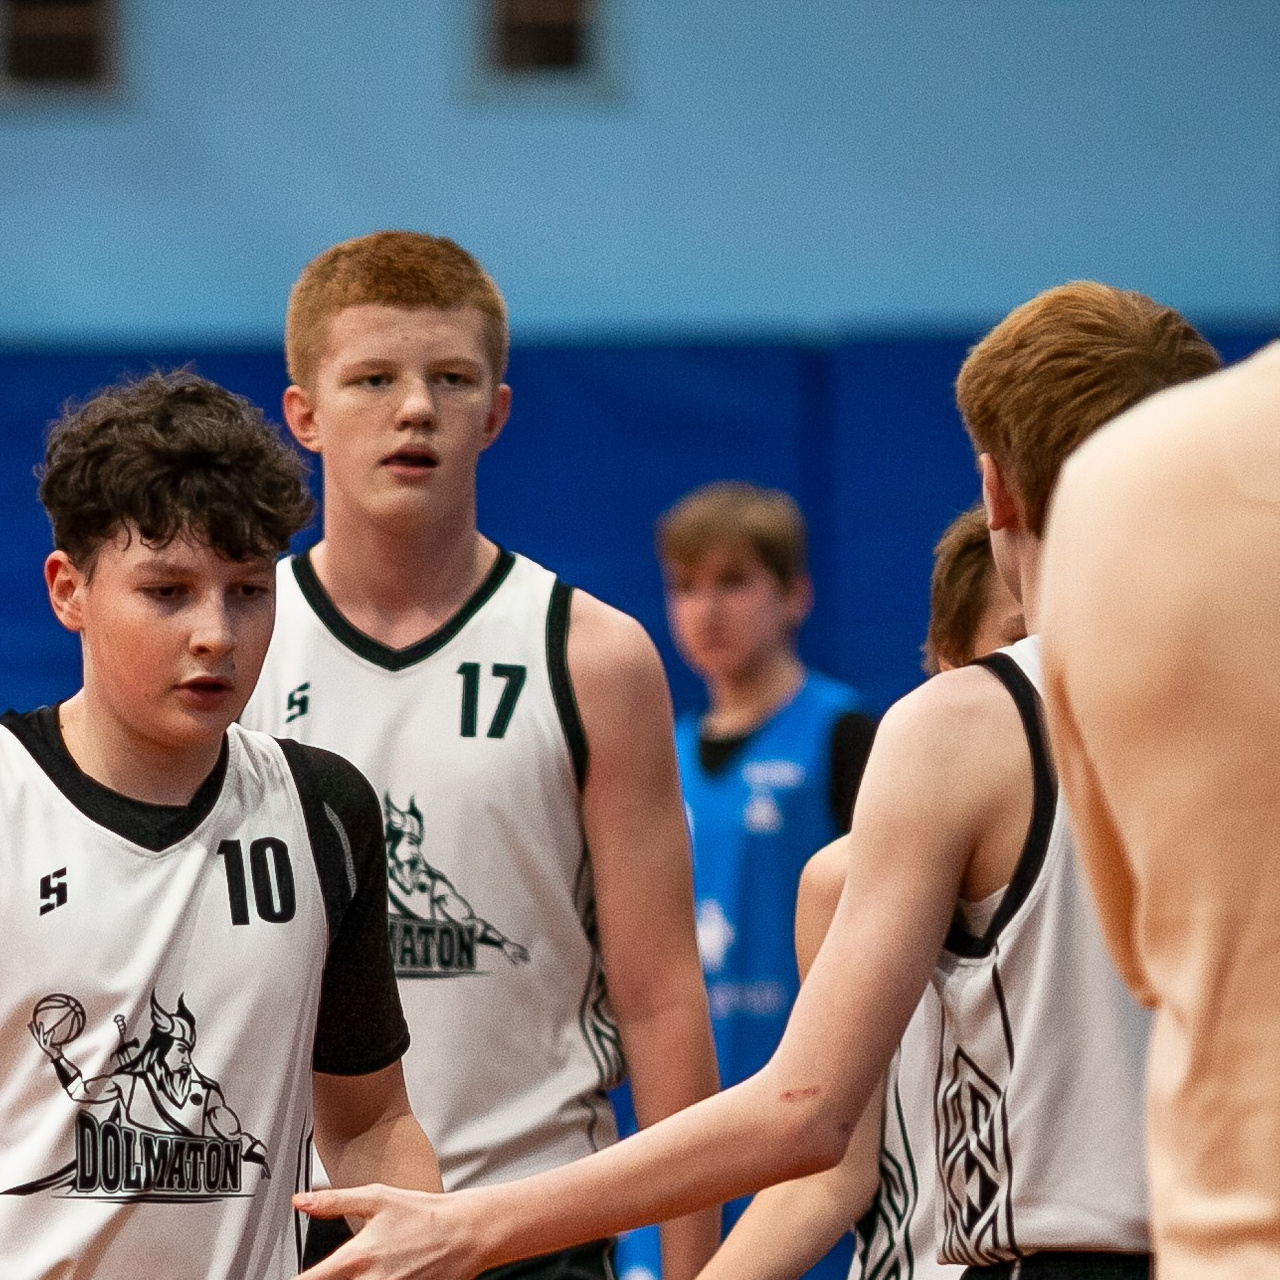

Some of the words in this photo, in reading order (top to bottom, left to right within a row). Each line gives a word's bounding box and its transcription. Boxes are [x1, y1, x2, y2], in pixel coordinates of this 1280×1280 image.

[456, 662, 527, 738] 17
[216, 837, 297, 926] 10
[389, 919, 476, 971] ATON
[76, 1109, 243, 1194] DOLMATON
